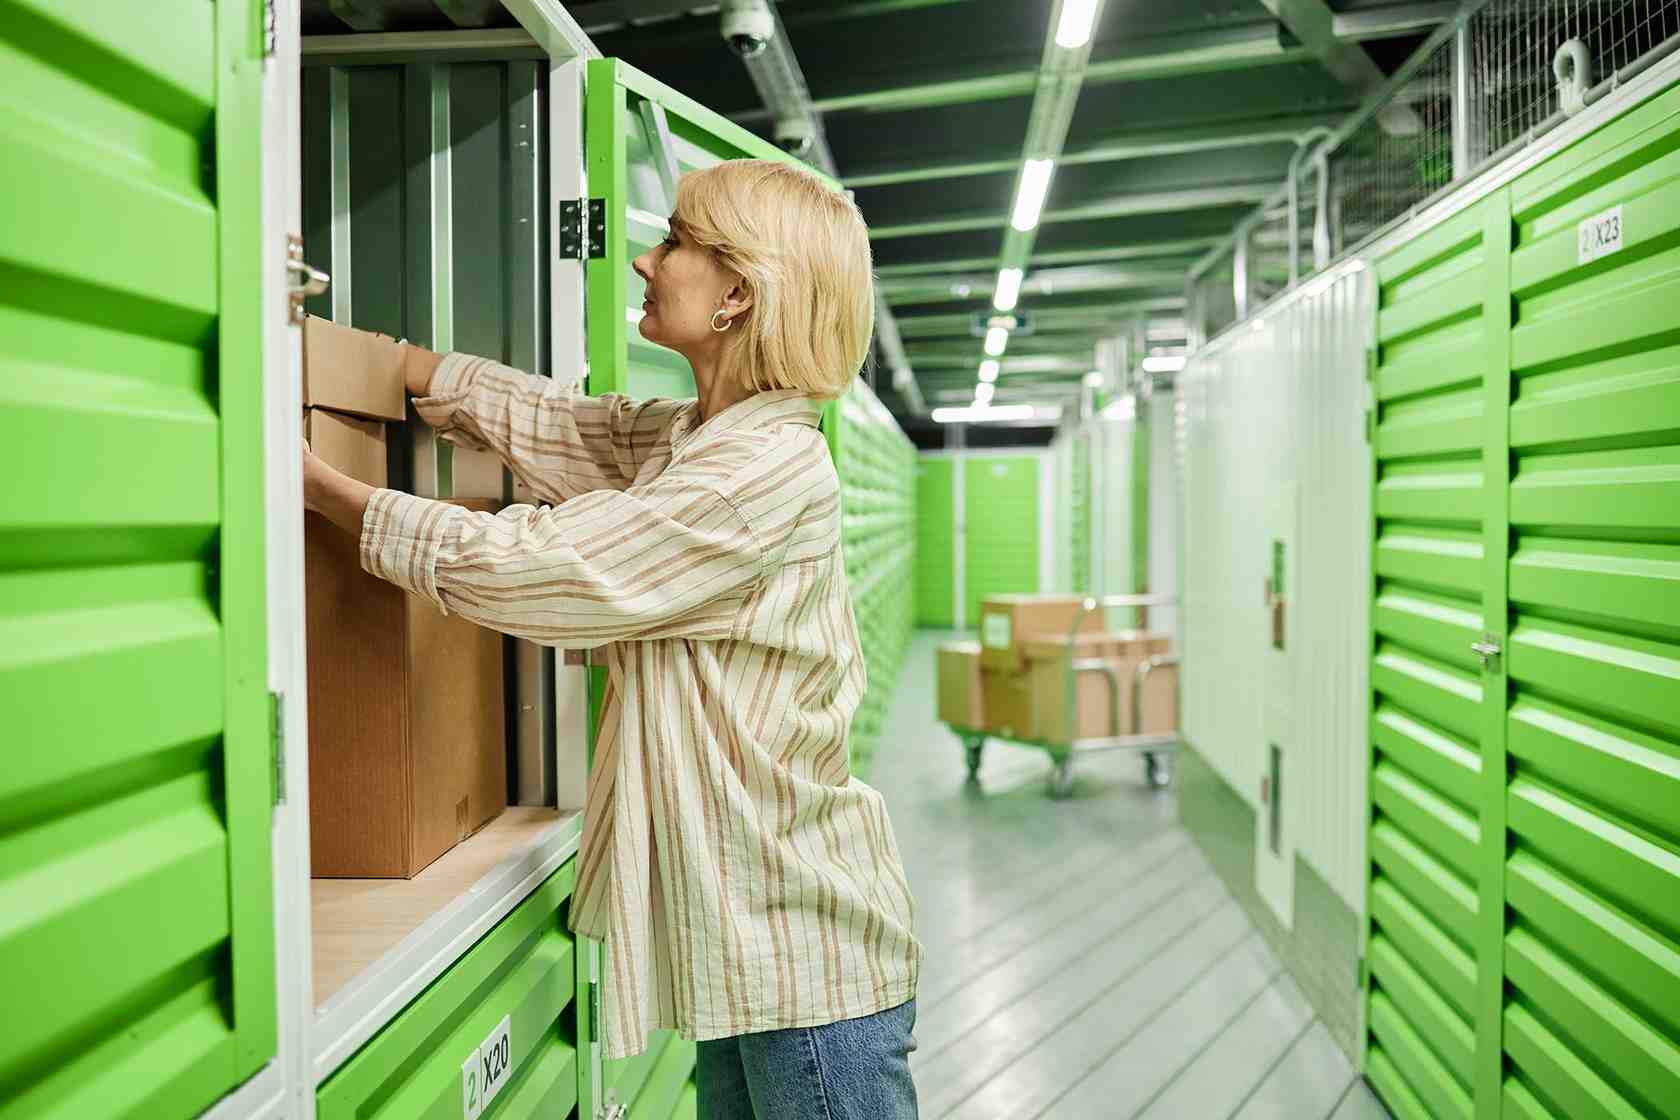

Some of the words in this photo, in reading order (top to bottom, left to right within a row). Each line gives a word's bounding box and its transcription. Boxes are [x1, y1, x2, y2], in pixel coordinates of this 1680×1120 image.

[1595, 215, 1620, 249] X23
[468, 1071, 477, 1110] 2
[483, 1033, 509, 1093] X20
